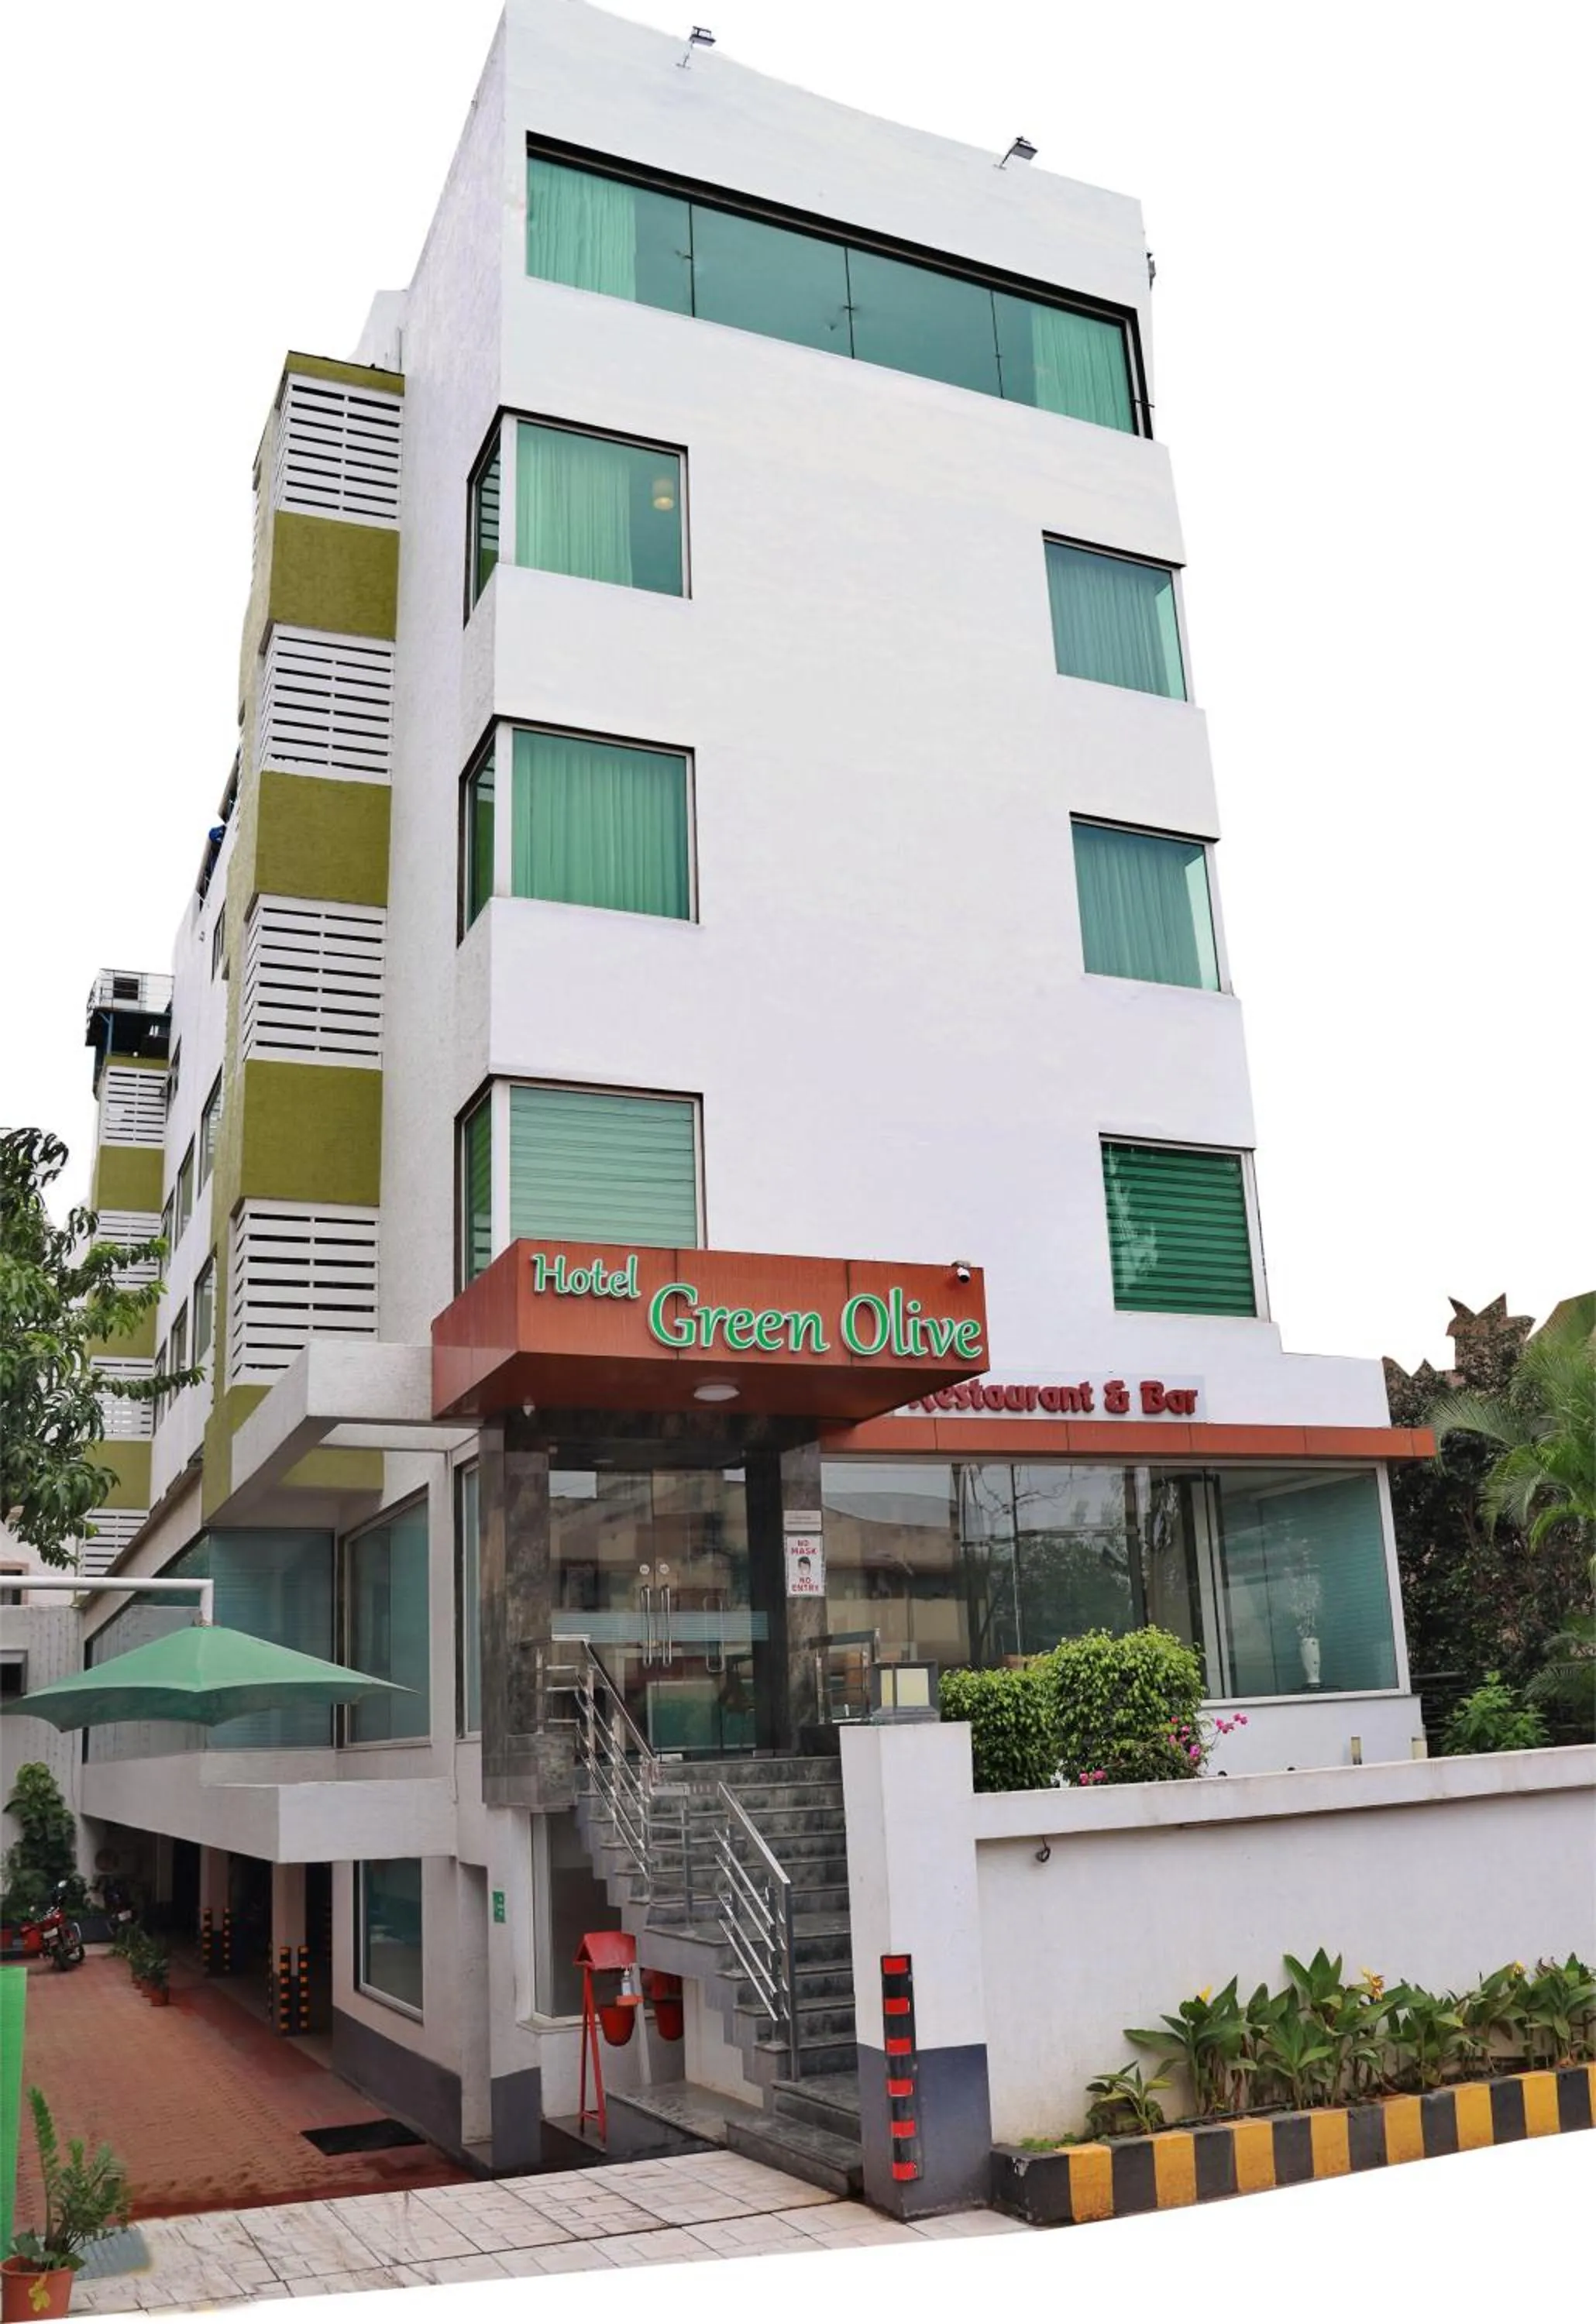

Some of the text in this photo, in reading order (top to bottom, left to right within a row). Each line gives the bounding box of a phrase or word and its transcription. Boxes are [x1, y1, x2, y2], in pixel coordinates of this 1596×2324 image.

[531, 1253, 640, 1298] Hotel
[648, 1283, 983, 1360] Green Olive
[908, 1377, 1199, 1415] estaurant & Bar
[791, 1547, 818, 1556] MASK
[792, 1584, 820, 1593] ENTRY
